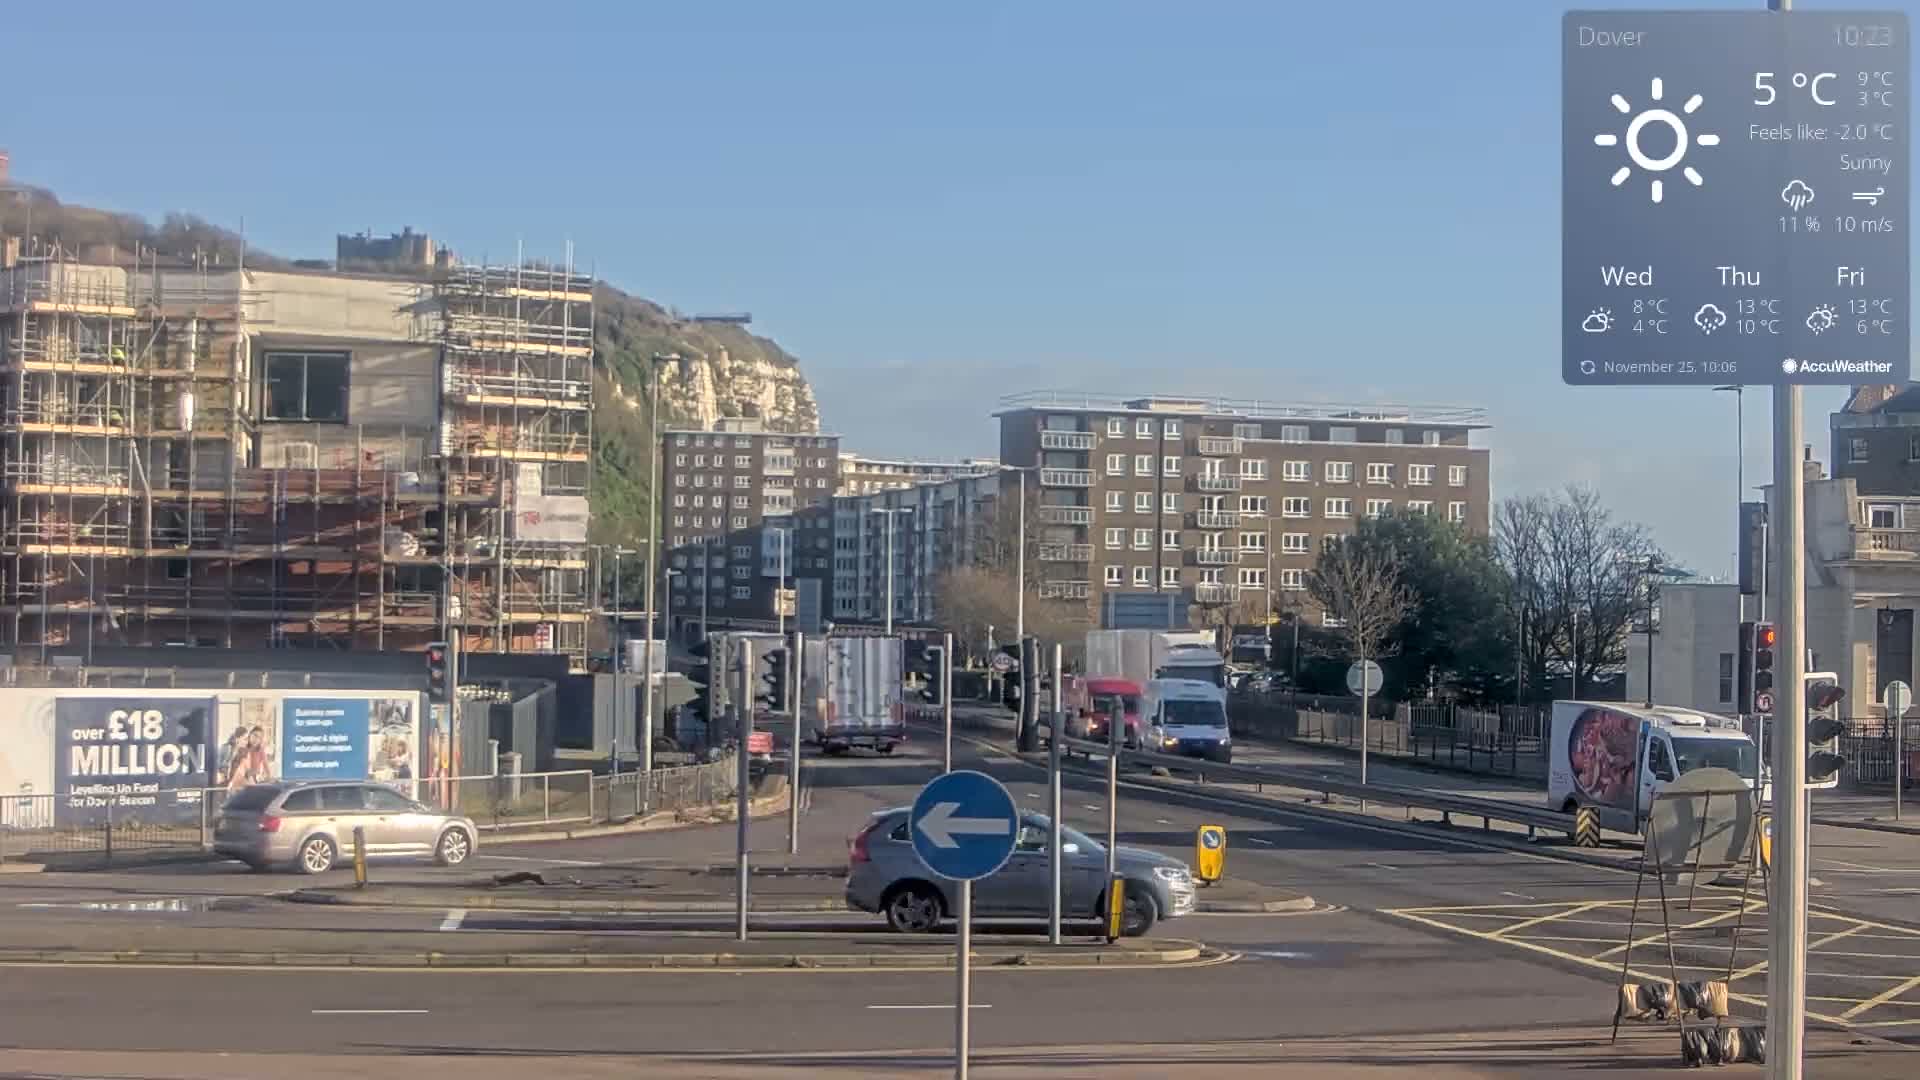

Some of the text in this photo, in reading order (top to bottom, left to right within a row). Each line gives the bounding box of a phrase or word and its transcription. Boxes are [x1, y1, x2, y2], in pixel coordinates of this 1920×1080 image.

[71, 709, 164, 741] over £18
[71, 743, 206, 776] MILLION
[70, 782, 159, 797] Levelling Up Fund
[70, 795, 156, 809] for Dovr Beacon
